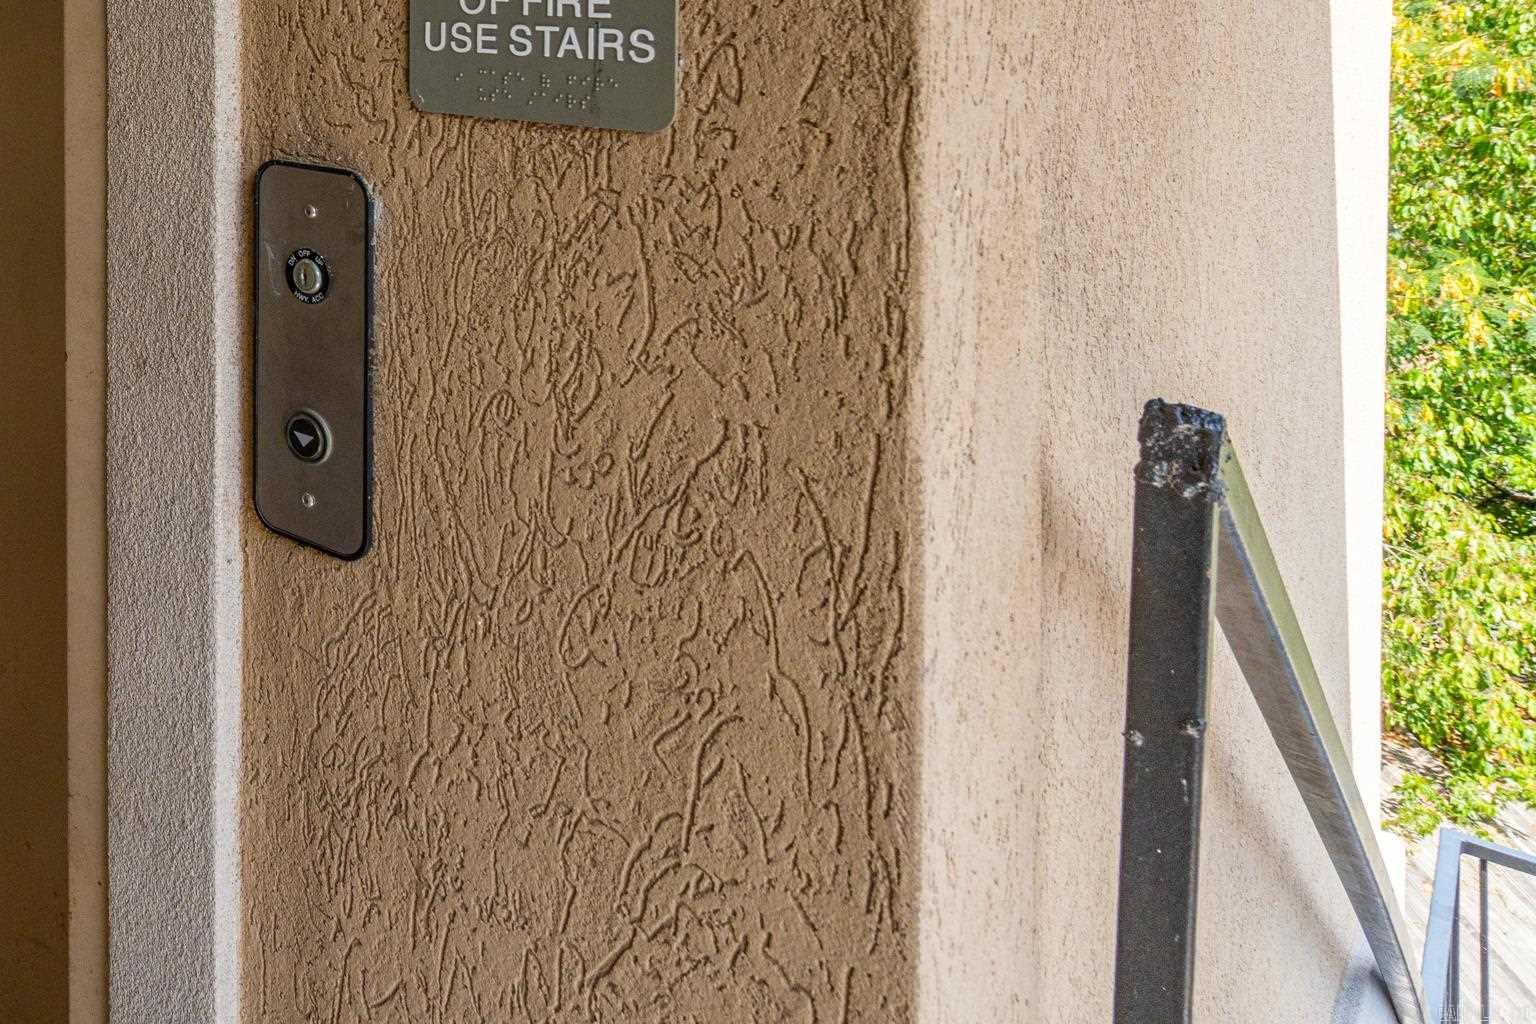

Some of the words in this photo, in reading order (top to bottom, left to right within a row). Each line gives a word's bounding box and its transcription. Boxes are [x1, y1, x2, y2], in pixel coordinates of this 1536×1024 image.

[424, 21, 498, 54] USE
[508, 24, 656, 63] STAIRS
[298, 249, 311, 257] OFF
